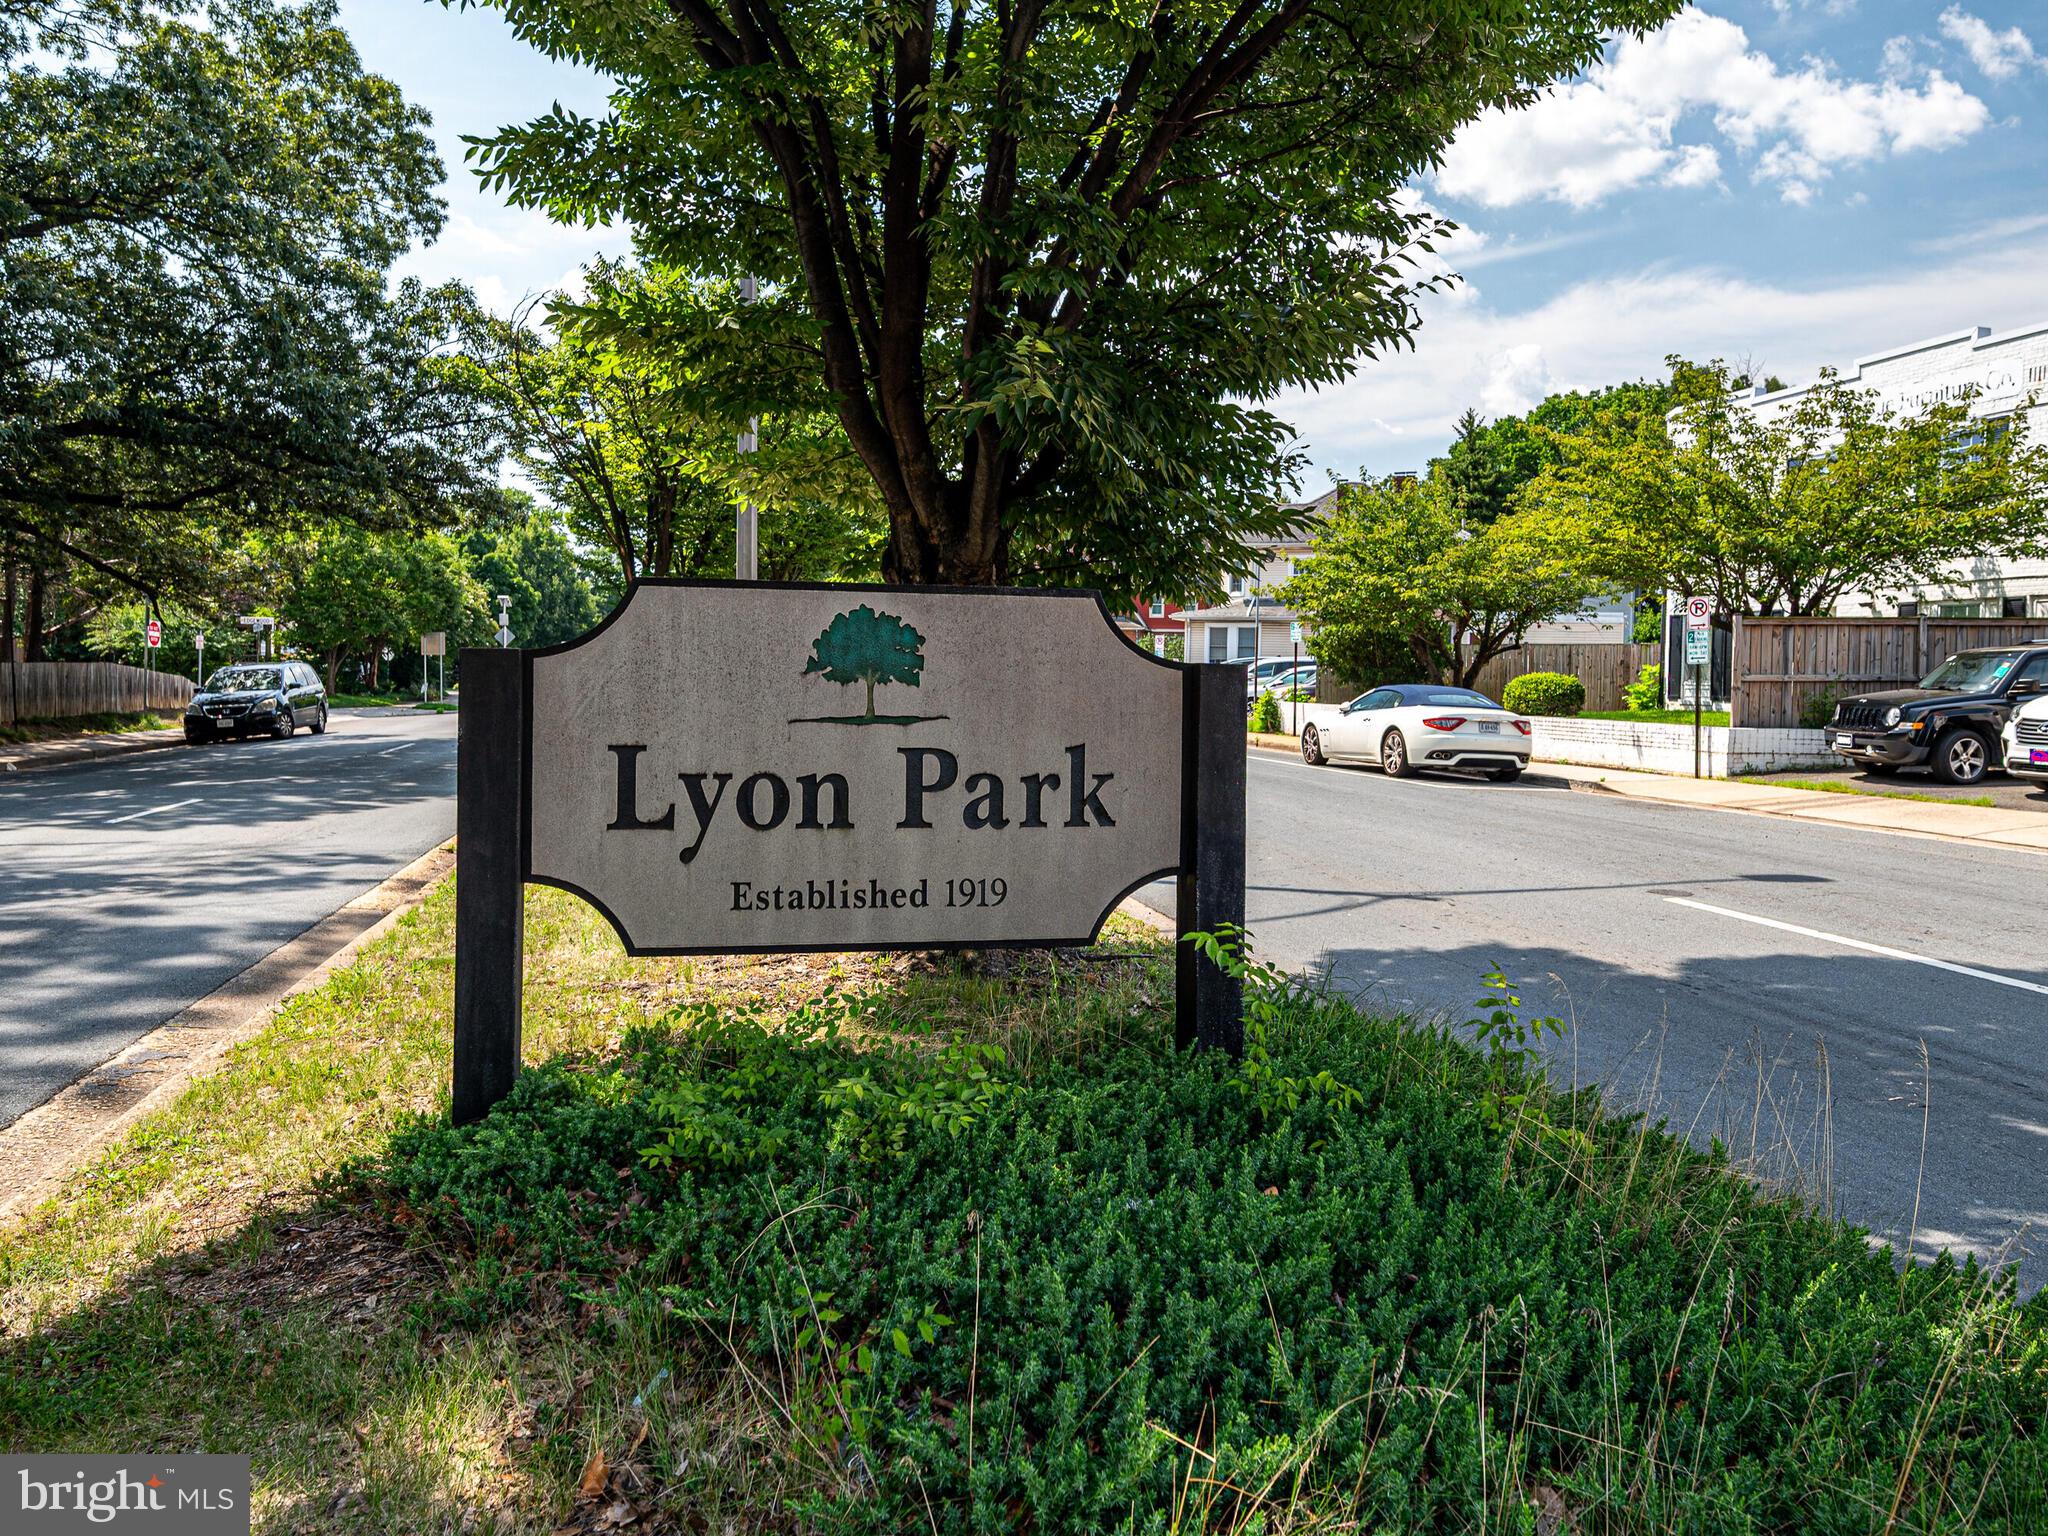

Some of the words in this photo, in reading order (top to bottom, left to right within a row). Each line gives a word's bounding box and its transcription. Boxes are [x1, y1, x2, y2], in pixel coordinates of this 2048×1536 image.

[606, 744, 855, 865] Lyon
[896, 743, 1117, 831] Park
[730, 878, 930, 911] Established
[945, 877, 1008, 908] 1919
